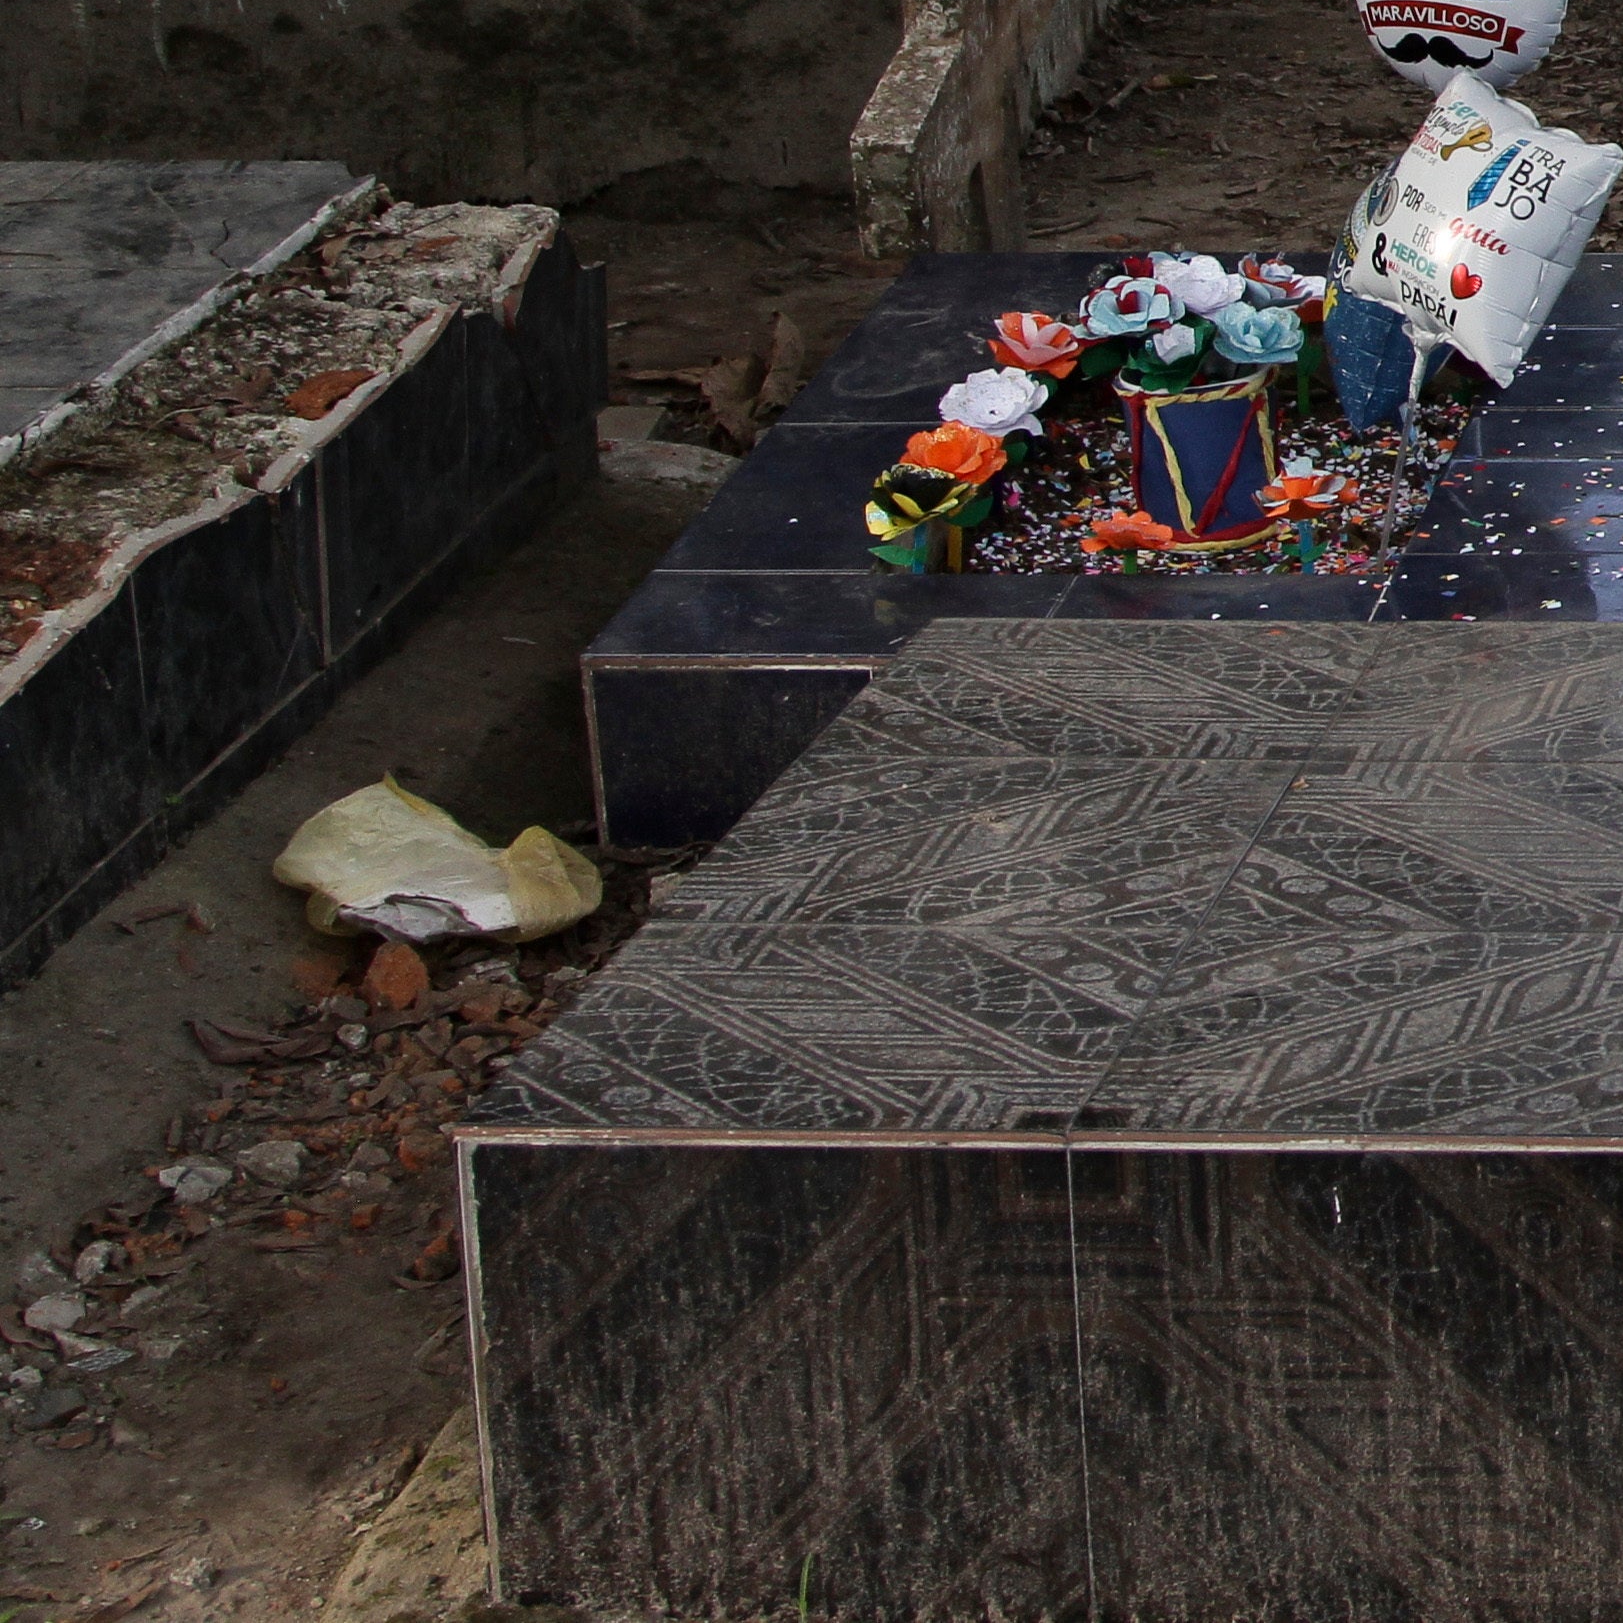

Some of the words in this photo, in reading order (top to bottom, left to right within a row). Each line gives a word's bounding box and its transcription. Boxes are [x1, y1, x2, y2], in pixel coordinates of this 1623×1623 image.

[1370, 5, 1498, 34] MARAVILLOSO
[1528, 146, 1566, 177] TRA
[1508, 159, 1556, 204] BA
[1400, 184, 1425, 213] POR
[1494, 185, 1535, 220] JO
[1390, 238, 1438, 280] HEROE
